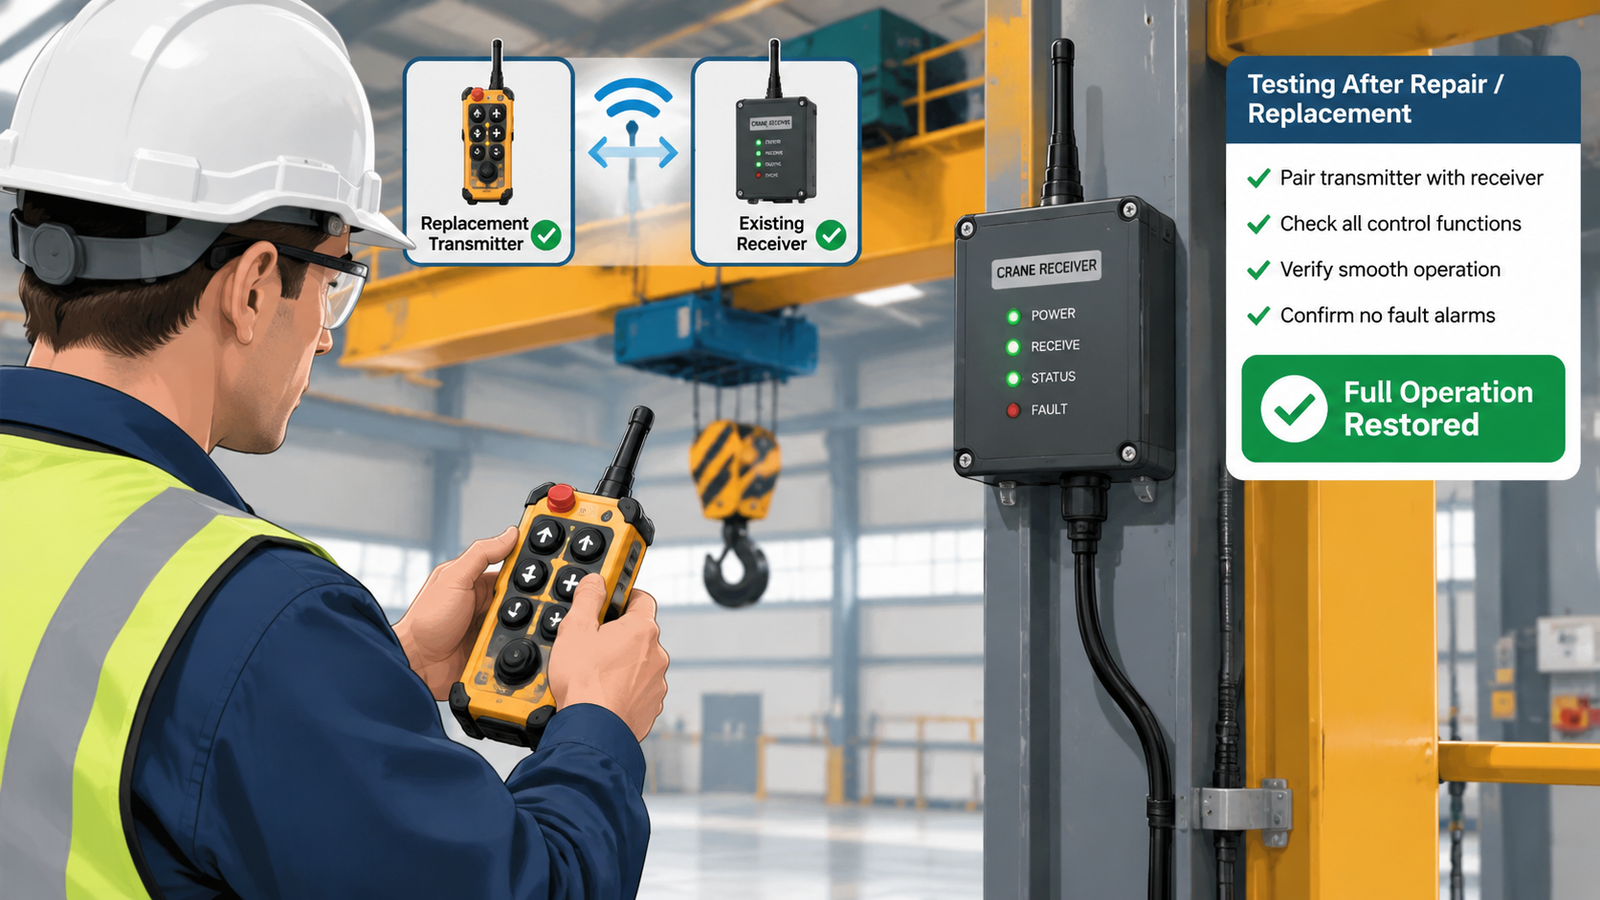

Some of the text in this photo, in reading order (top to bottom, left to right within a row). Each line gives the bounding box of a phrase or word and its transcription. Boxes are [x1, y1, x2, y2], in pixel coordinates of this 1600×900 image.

[997, 258, 1097, 279] CRANE RECEIVER
[1032, 308, 1075, 321] POWER
[1032, 339, 1079, 352] RECEIVE
[1032, 371, 1076, 384] STATUS
[1032, 403, 1067, 416] FAULT
